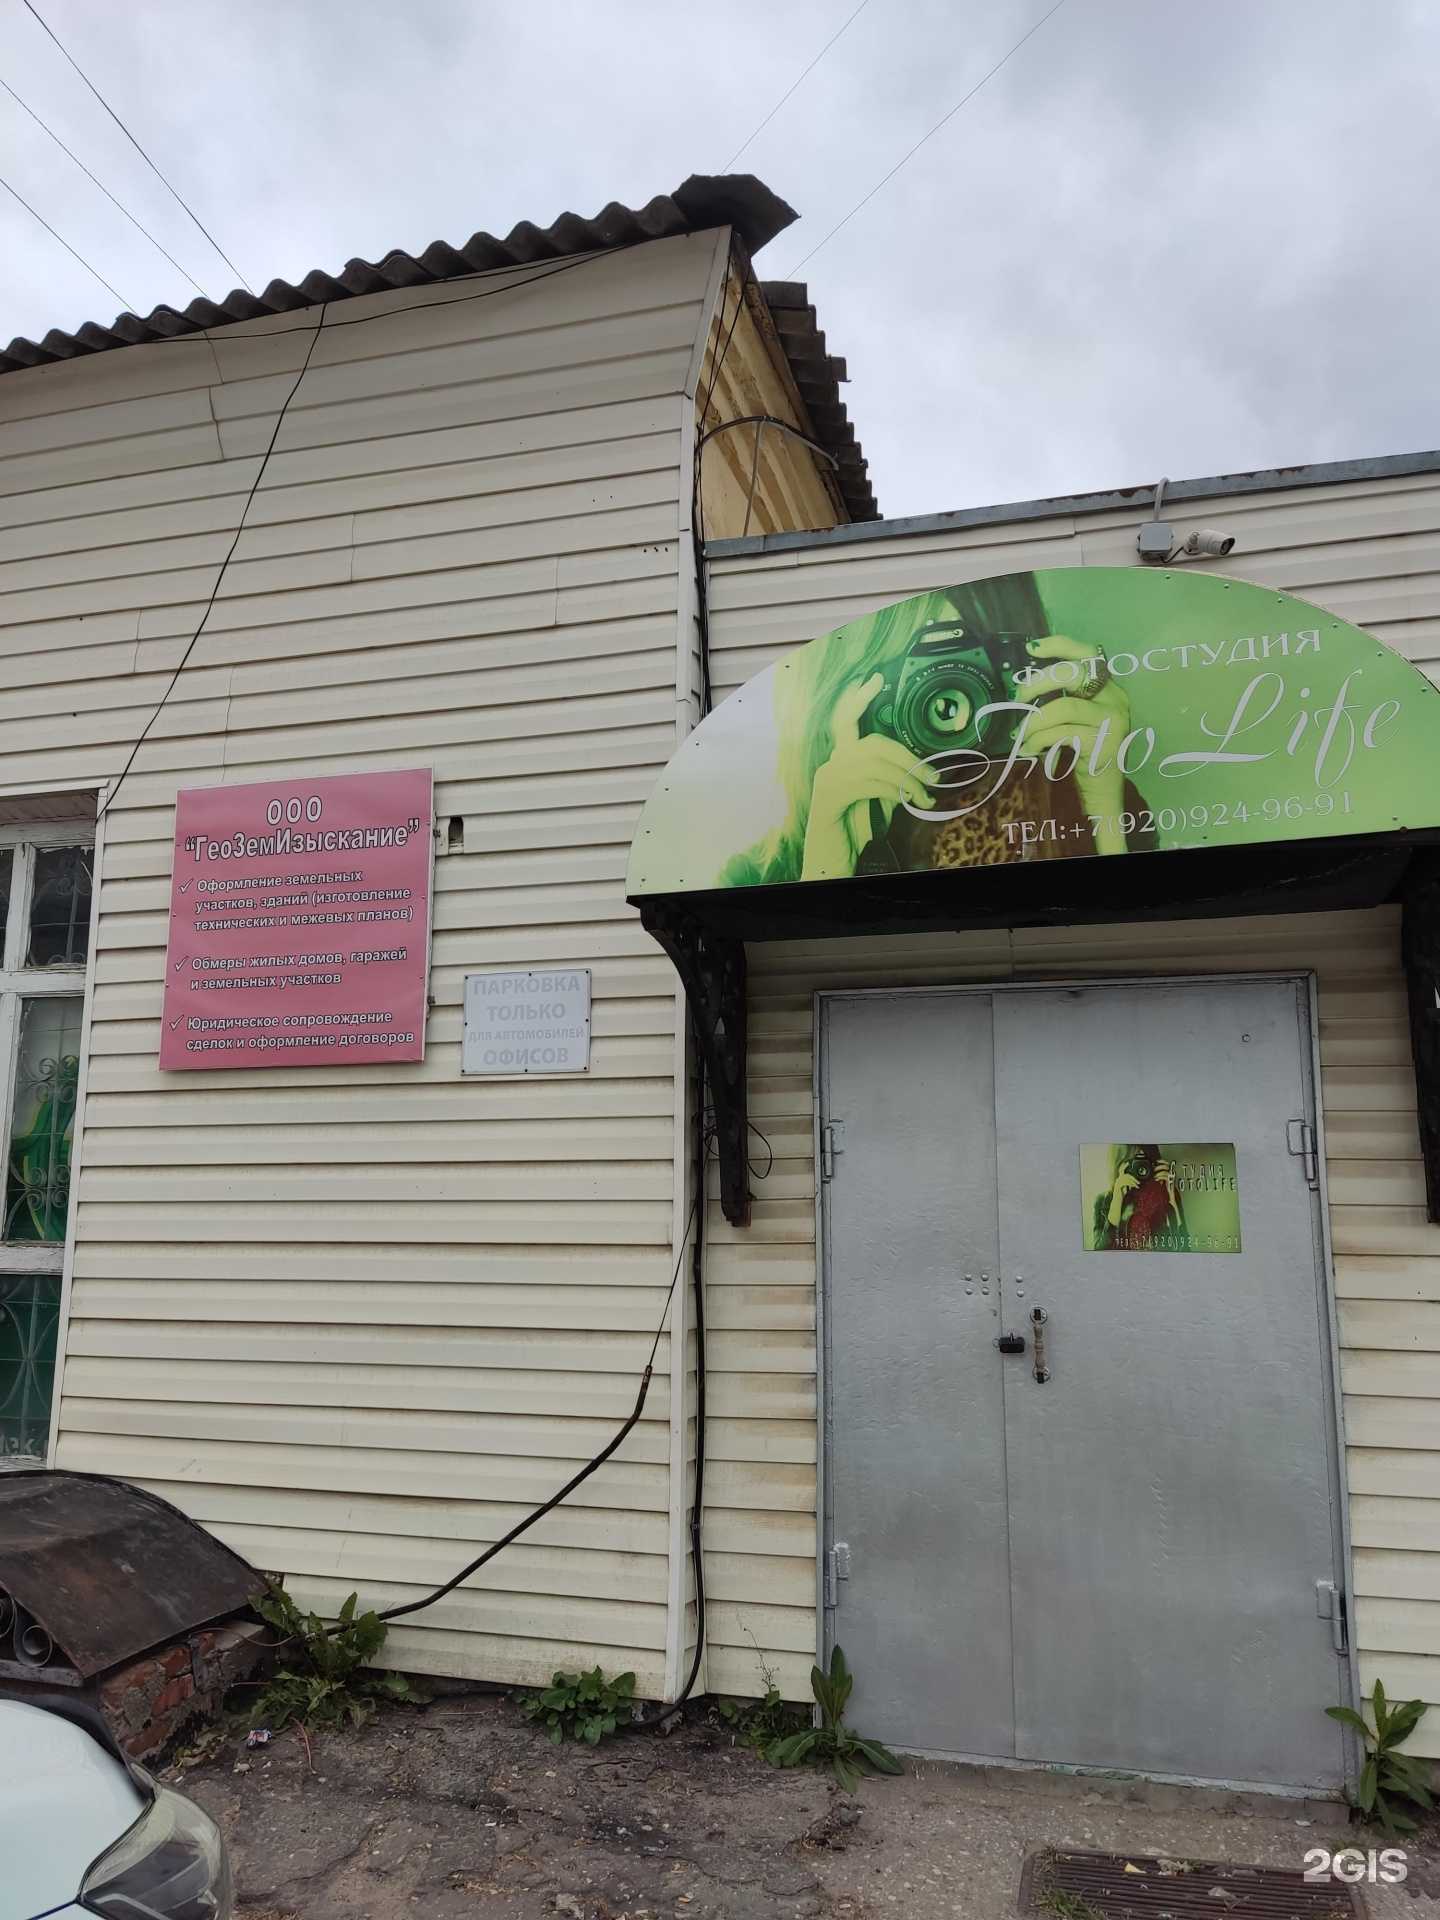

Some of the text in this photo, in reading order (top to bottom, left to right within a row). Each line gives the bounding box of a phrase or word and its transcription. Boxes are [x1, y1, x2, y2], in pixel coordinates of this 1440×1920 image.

[1012, 629, 1321, 688] ФОТОСТУДИЯ
[901, 669, 1402, 821] Foto Life
[266, 795, 323, 826] ООО
[197, 870, 362, 893] Оформление земельных
[195, 888, 411, 914] участков, зданий (изготовление
[195, 906, 414, 931] технических и межевых планов)
[192, 946, 408, 971] Обмеры жилых домов, гаражей
[191, 973, 342, 991] и земельных участков
[473, 975, 581, 995] ПАРКОВКА
[187, 1011, 392, 1031] Юридическое сопровождение
[486, 1003, 566, 1022] ТОЛЬКО
[186, 1031, 414, 1051] сделок и оформление договоров
[483, 1047, 569, 1065] ОФИСОВ
